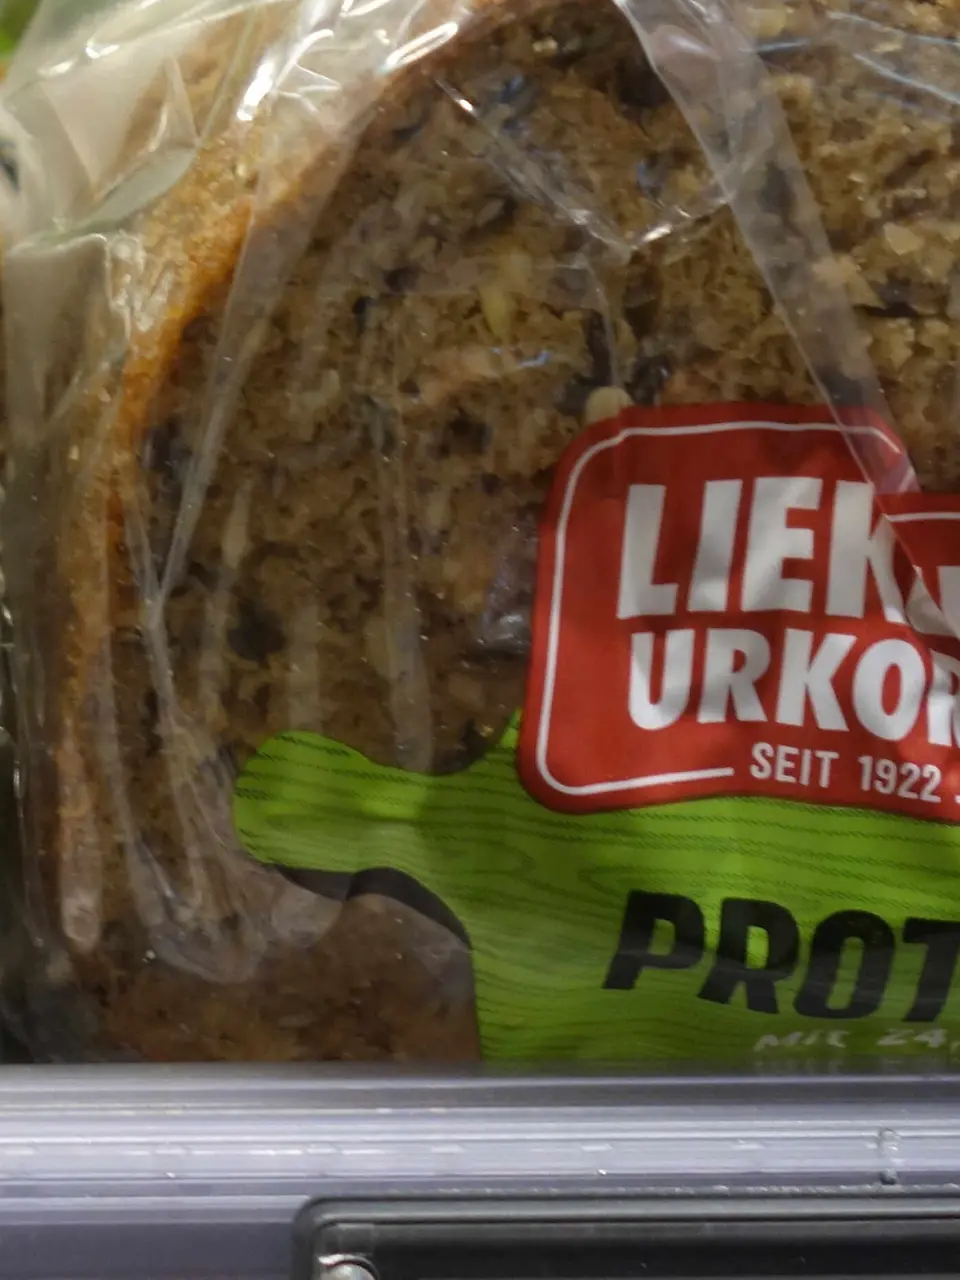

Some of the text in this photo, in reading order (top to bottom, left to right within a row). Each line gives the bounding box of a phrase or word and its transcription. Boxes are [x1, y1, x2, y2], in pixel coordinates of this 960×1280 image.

[616, 475, 960, 638] LIEK
[749, 741, 942, 803] SEIT 1922
[602, 888, 960, 1022] PROT
